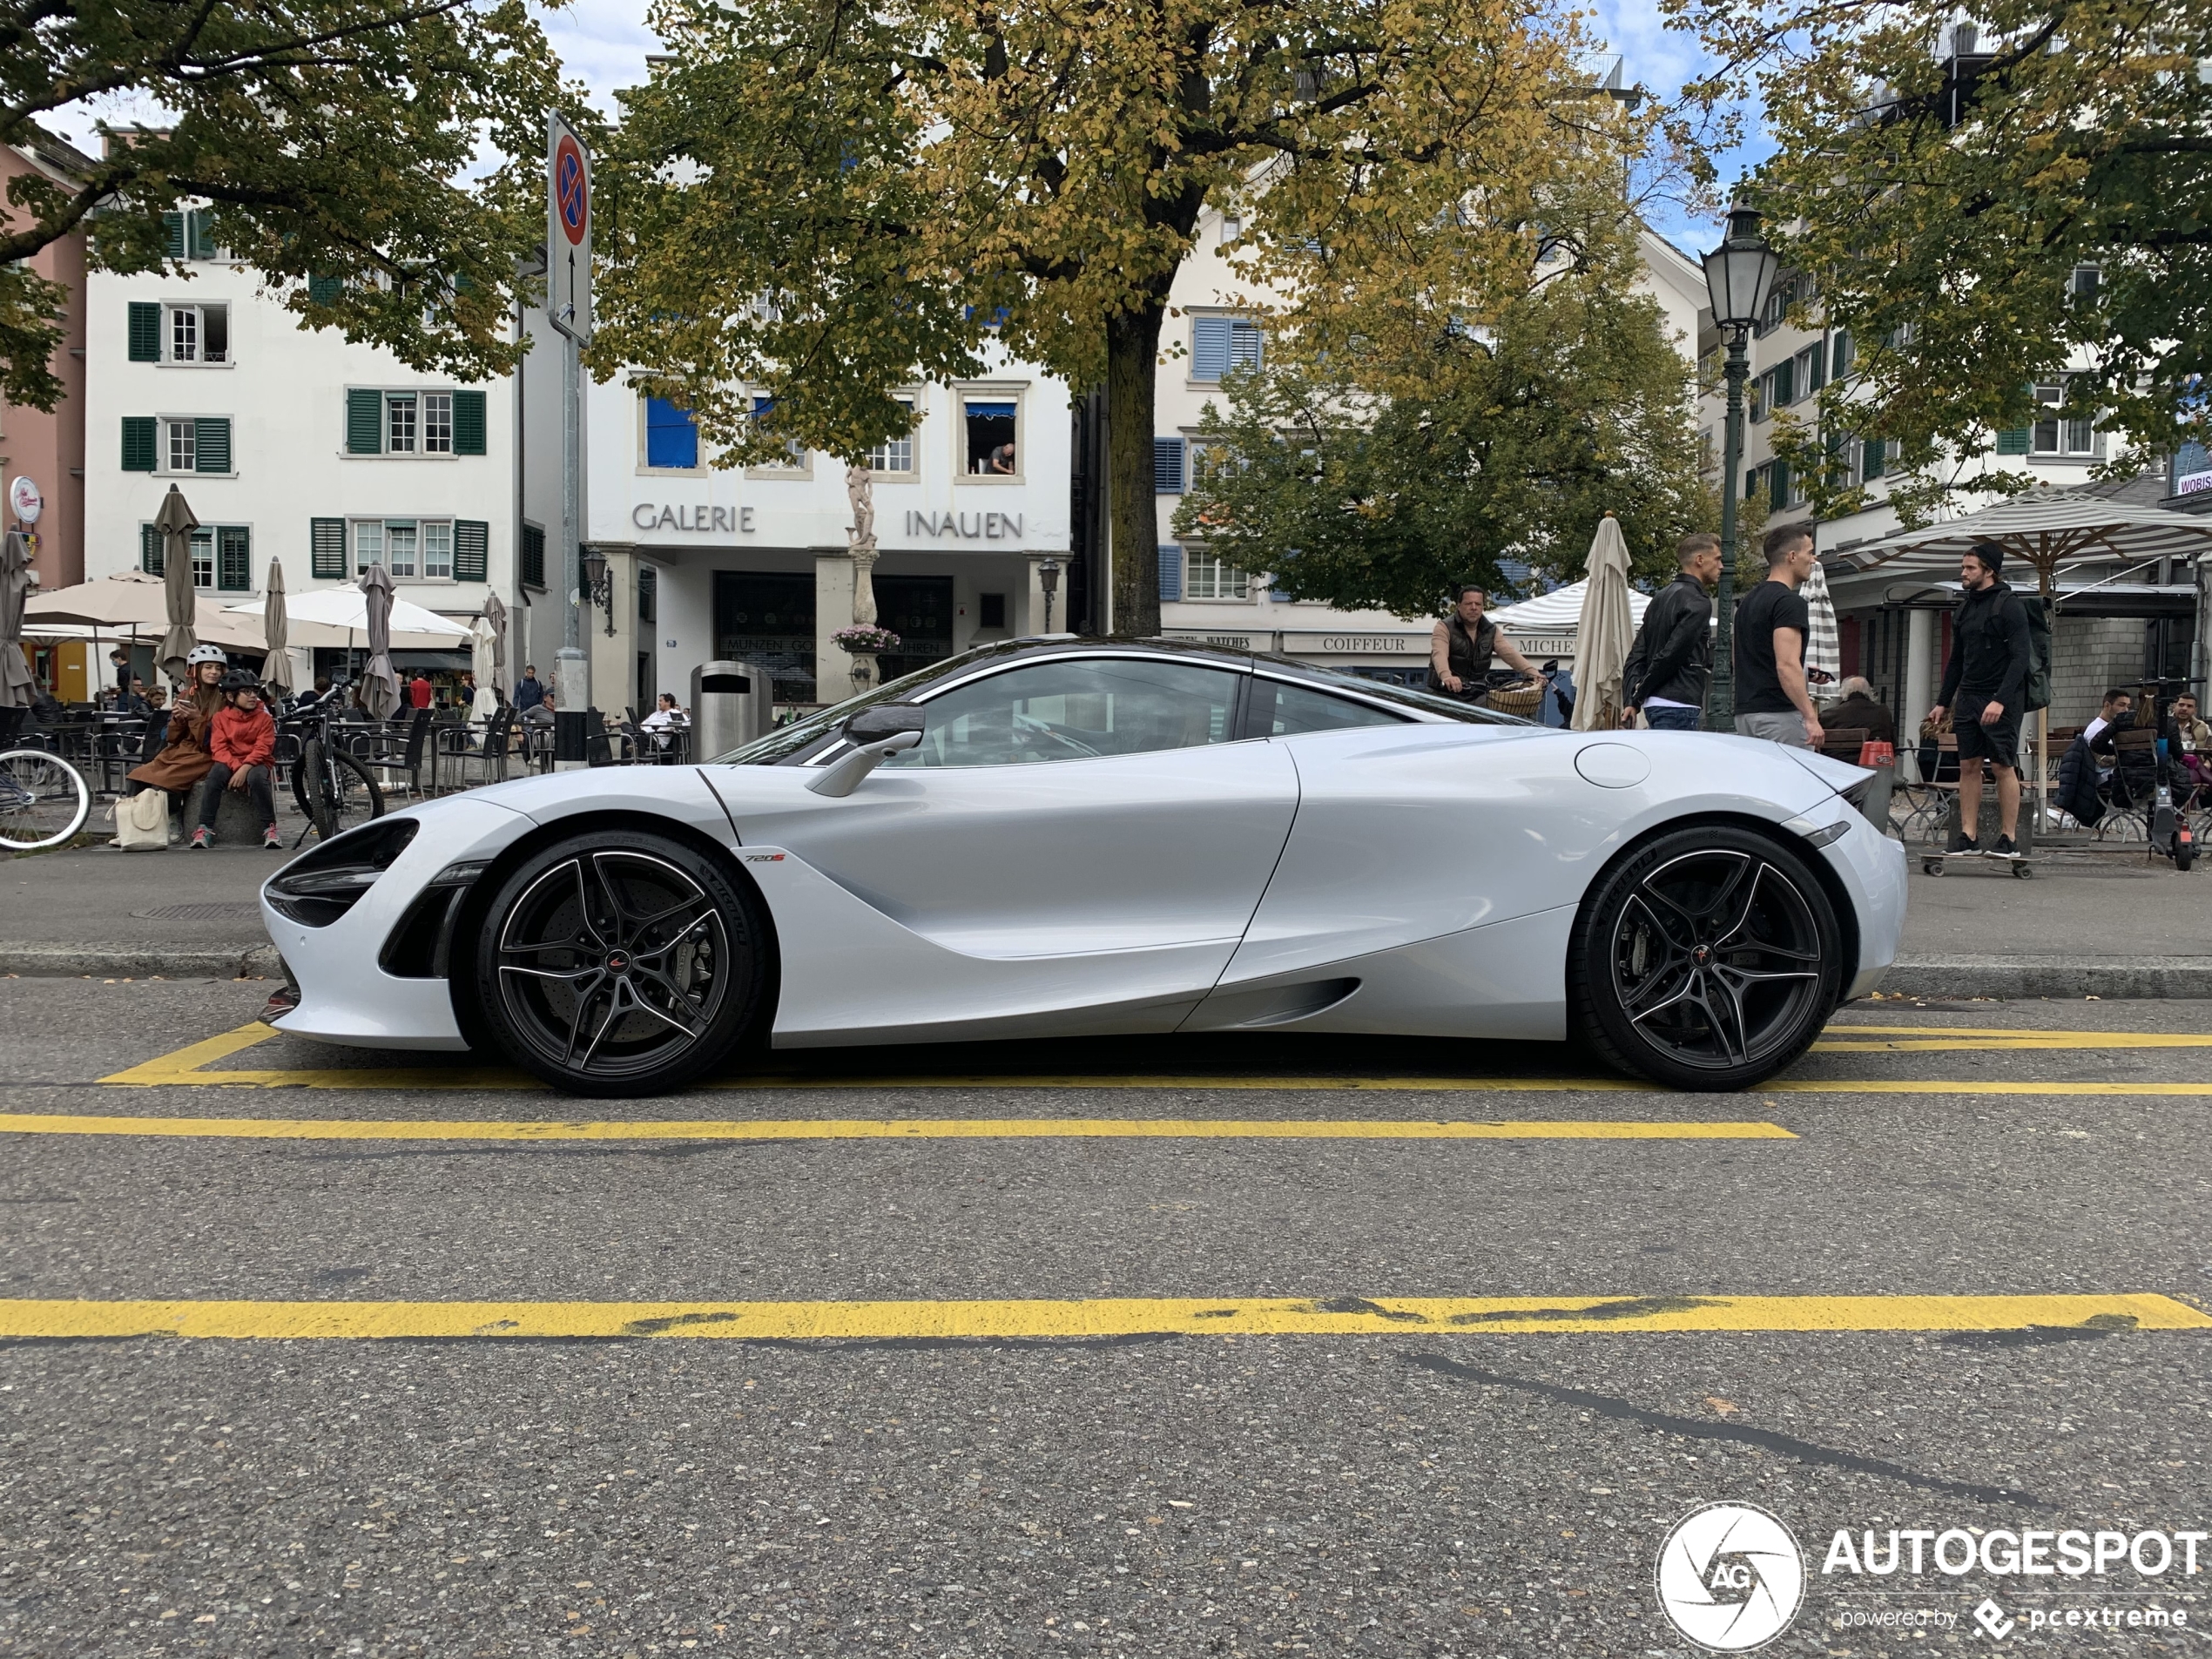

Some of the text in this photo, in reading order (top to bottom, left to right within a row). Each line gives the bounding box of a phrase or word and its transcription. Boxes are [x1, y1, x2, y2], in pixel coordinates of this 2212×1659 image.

[2181, 475, 2212, 494] WOBIS
[632, 502, 1023, 539] GALERIE INAUEN
[1323, 637, 1578, 653] COIFFEUR MICHE
[745, 853, 786, 862] 720S
